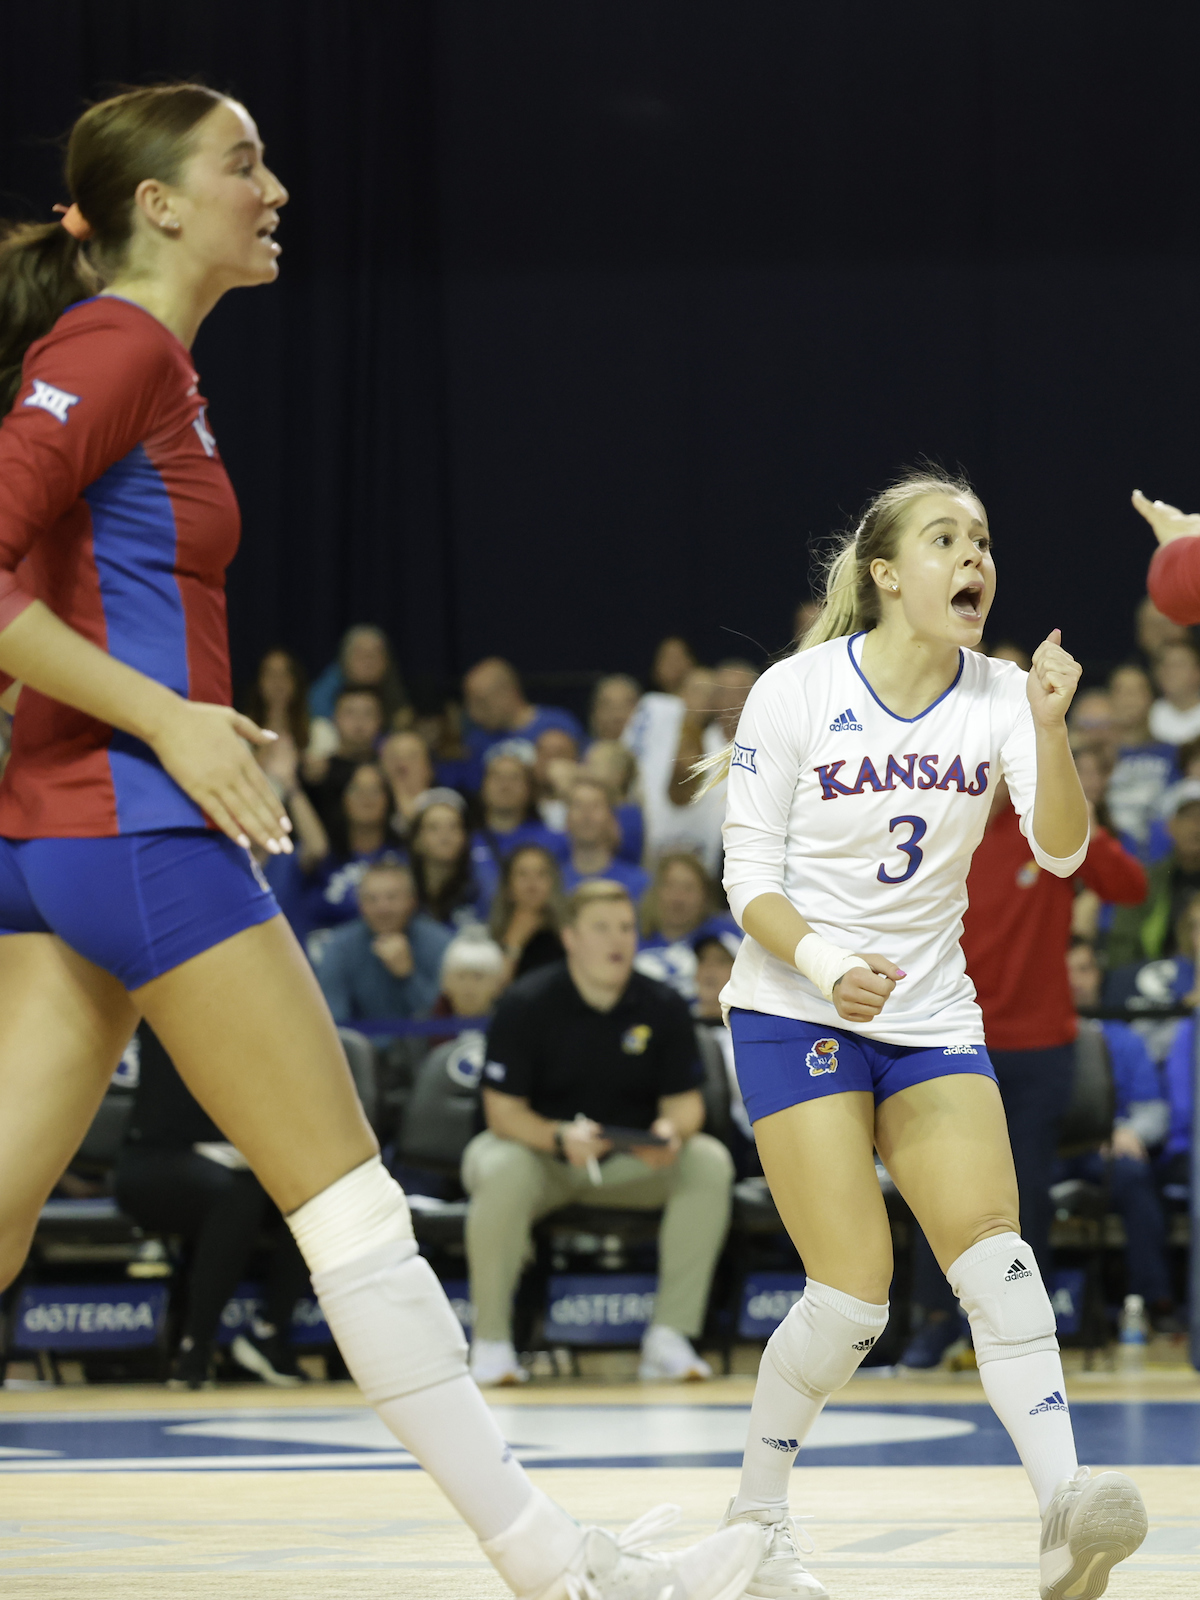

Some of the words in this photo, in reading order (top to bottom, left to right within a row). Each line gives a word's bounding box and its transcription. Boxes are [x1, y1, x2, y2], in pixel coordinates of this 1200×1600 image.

[829, 722, 863, 732] adidas
[813, 753, 991, 801] KANSAS
[876, 815, 928, 884] 3
[942, 1046, 978, 1056] adidas
[1004, 1267, 1033, 1282] adidas
